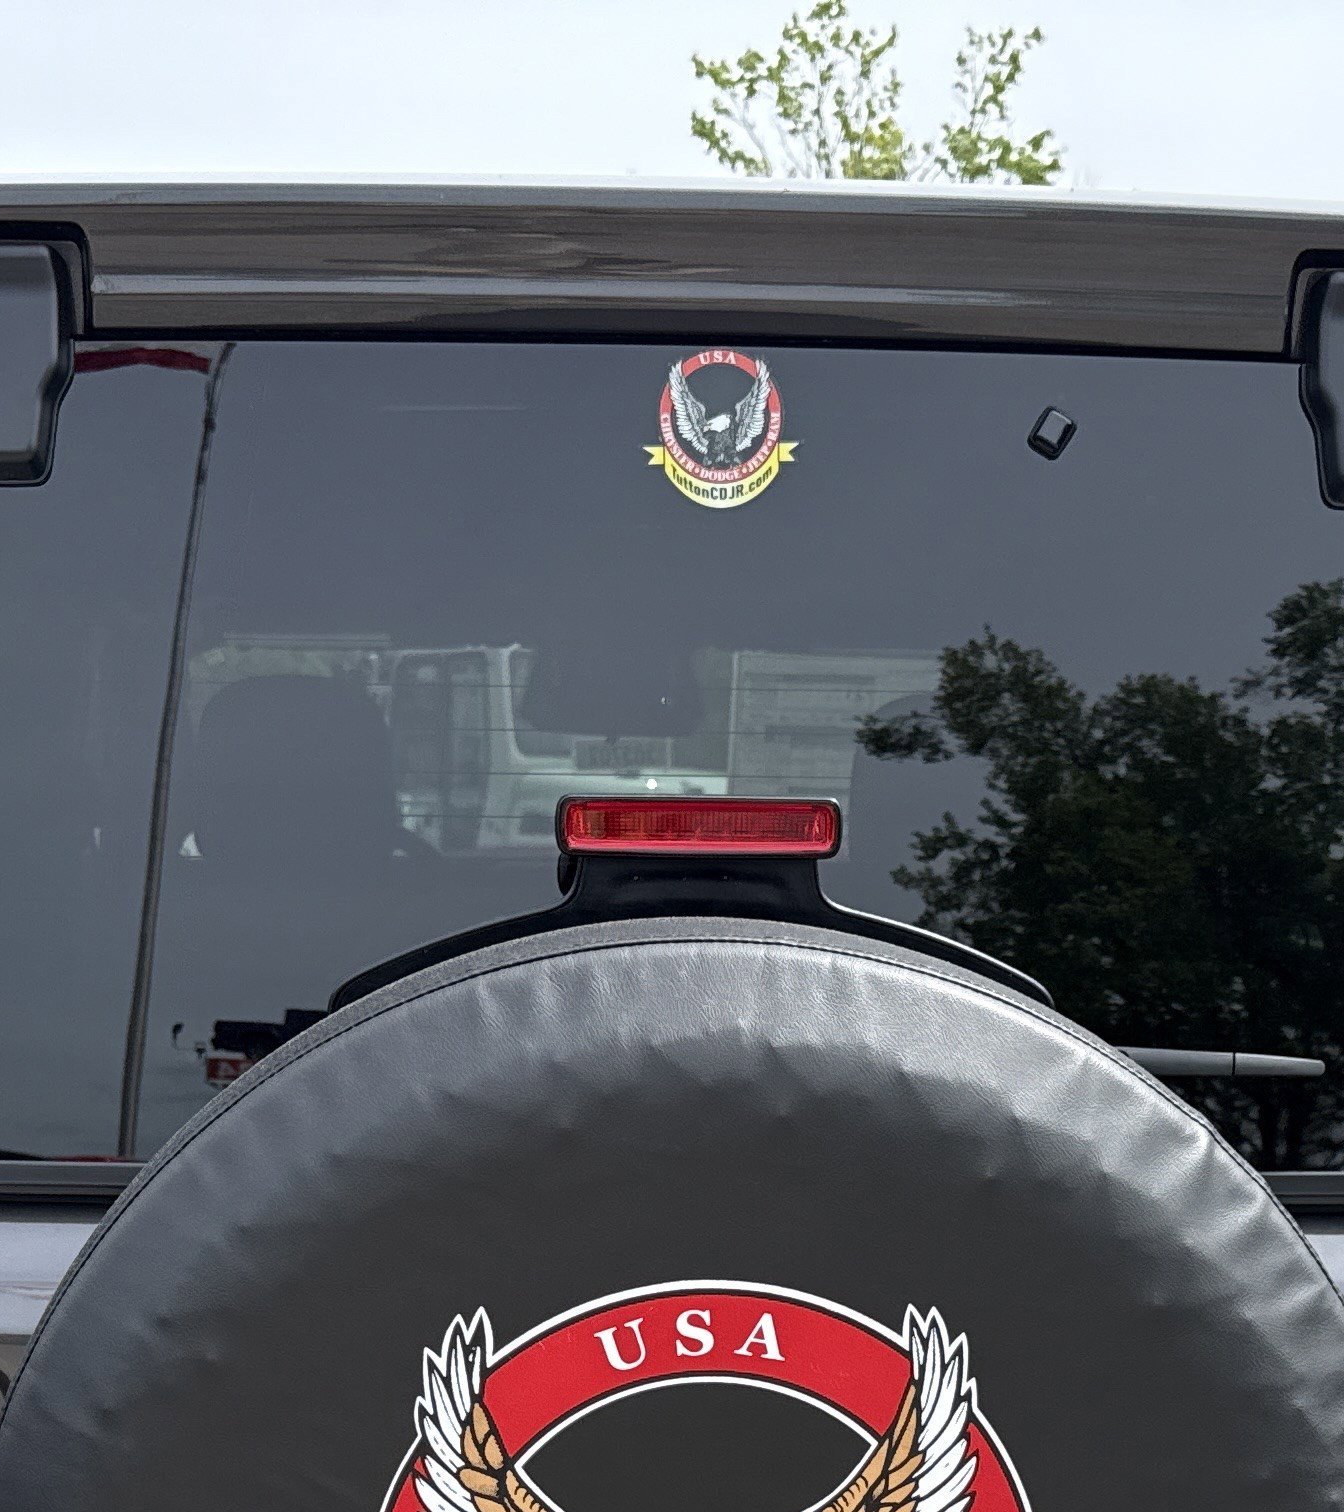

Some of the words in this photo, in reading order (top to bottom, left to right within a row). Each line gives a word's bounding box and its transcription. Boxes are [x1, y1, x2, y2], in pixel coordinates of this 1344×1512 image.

[698, 350, 737, 365] USA
[670, 464, 773, 500] TuttonCDJR.com
[699, 468, 742, 482] DODGE
[595, 1309, 785, 1373] USA
